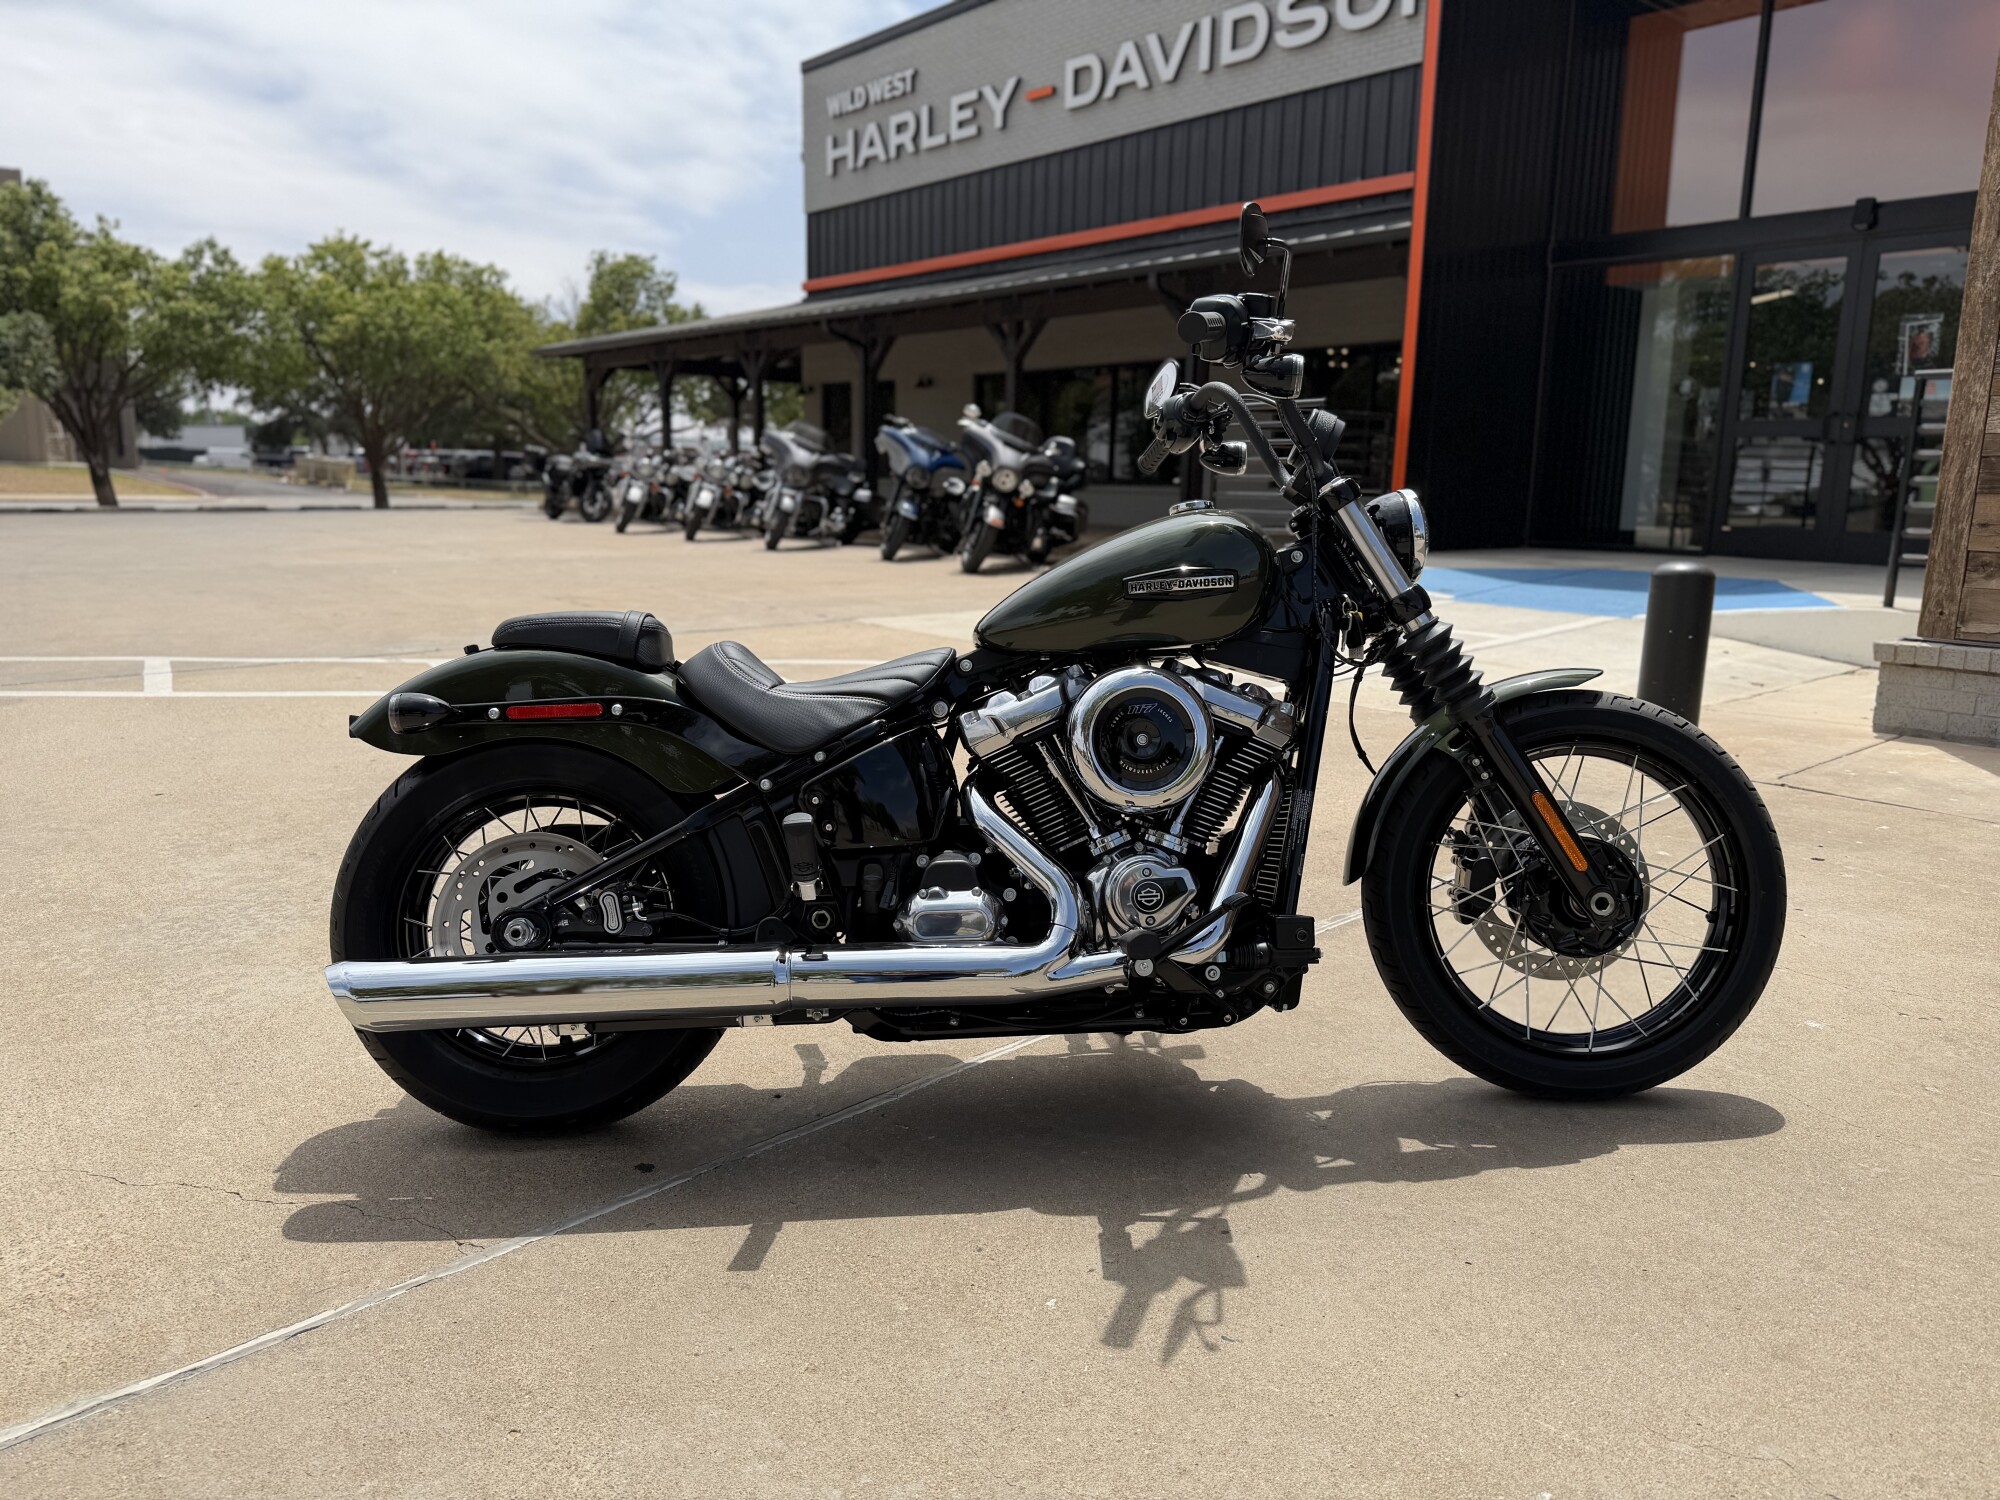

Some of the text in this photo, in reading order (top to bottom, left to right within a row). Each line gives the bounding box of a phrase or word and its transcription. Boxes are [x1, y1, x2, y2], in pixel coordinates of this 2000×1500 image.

[826, 0, 1416, 176] HARLEY-DAVIDS
[826, 68, 917, 118] WILD WEST
[1129, 577, 1233, 593] HARLEY-DAVIDSON
